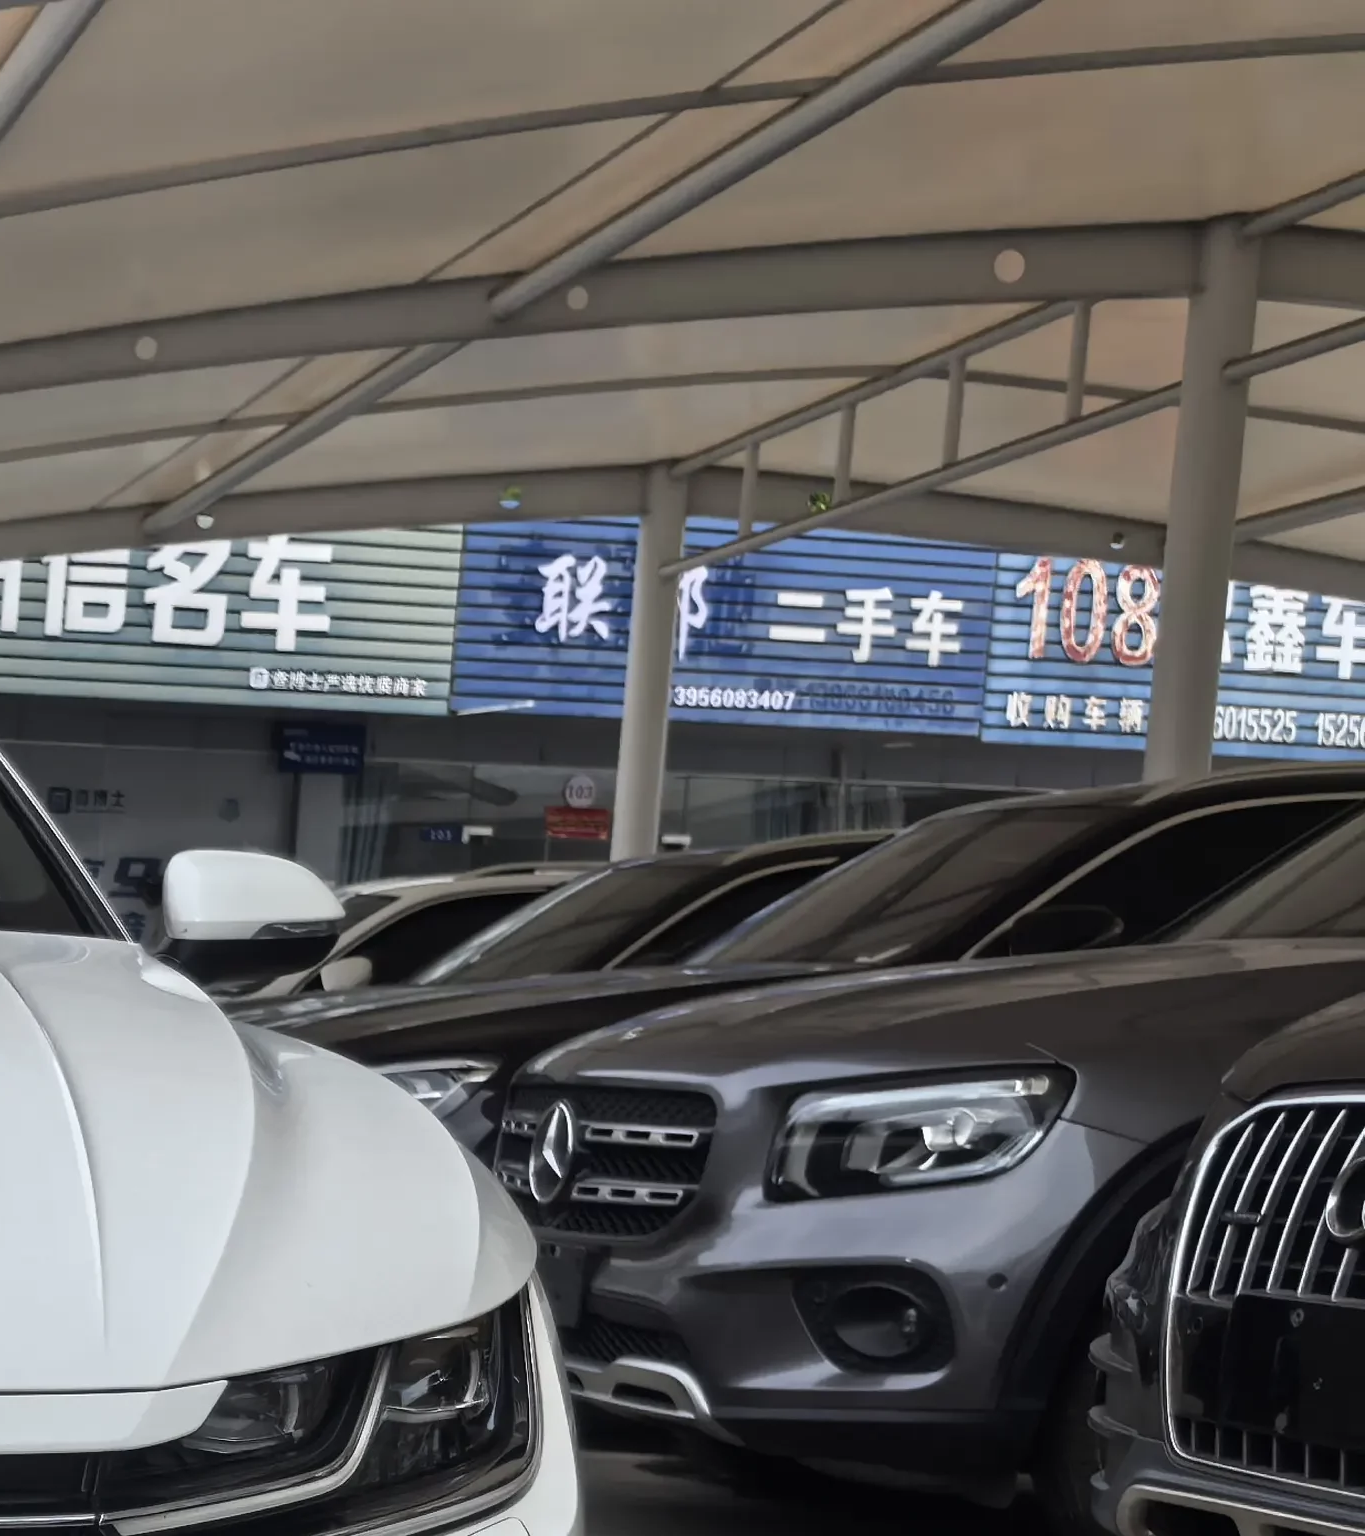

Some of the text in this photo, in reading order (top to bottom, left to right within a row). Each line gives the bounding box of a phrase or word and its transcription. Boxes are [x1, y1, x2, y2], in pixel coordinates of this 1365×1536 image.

[769, 587, 964, 666] 二手车
[1016, 556, 1161, 666] 108
[1221, 580, 1365, 680] 鑫车
[1006, 691, 1145, 733] 收购车辆
